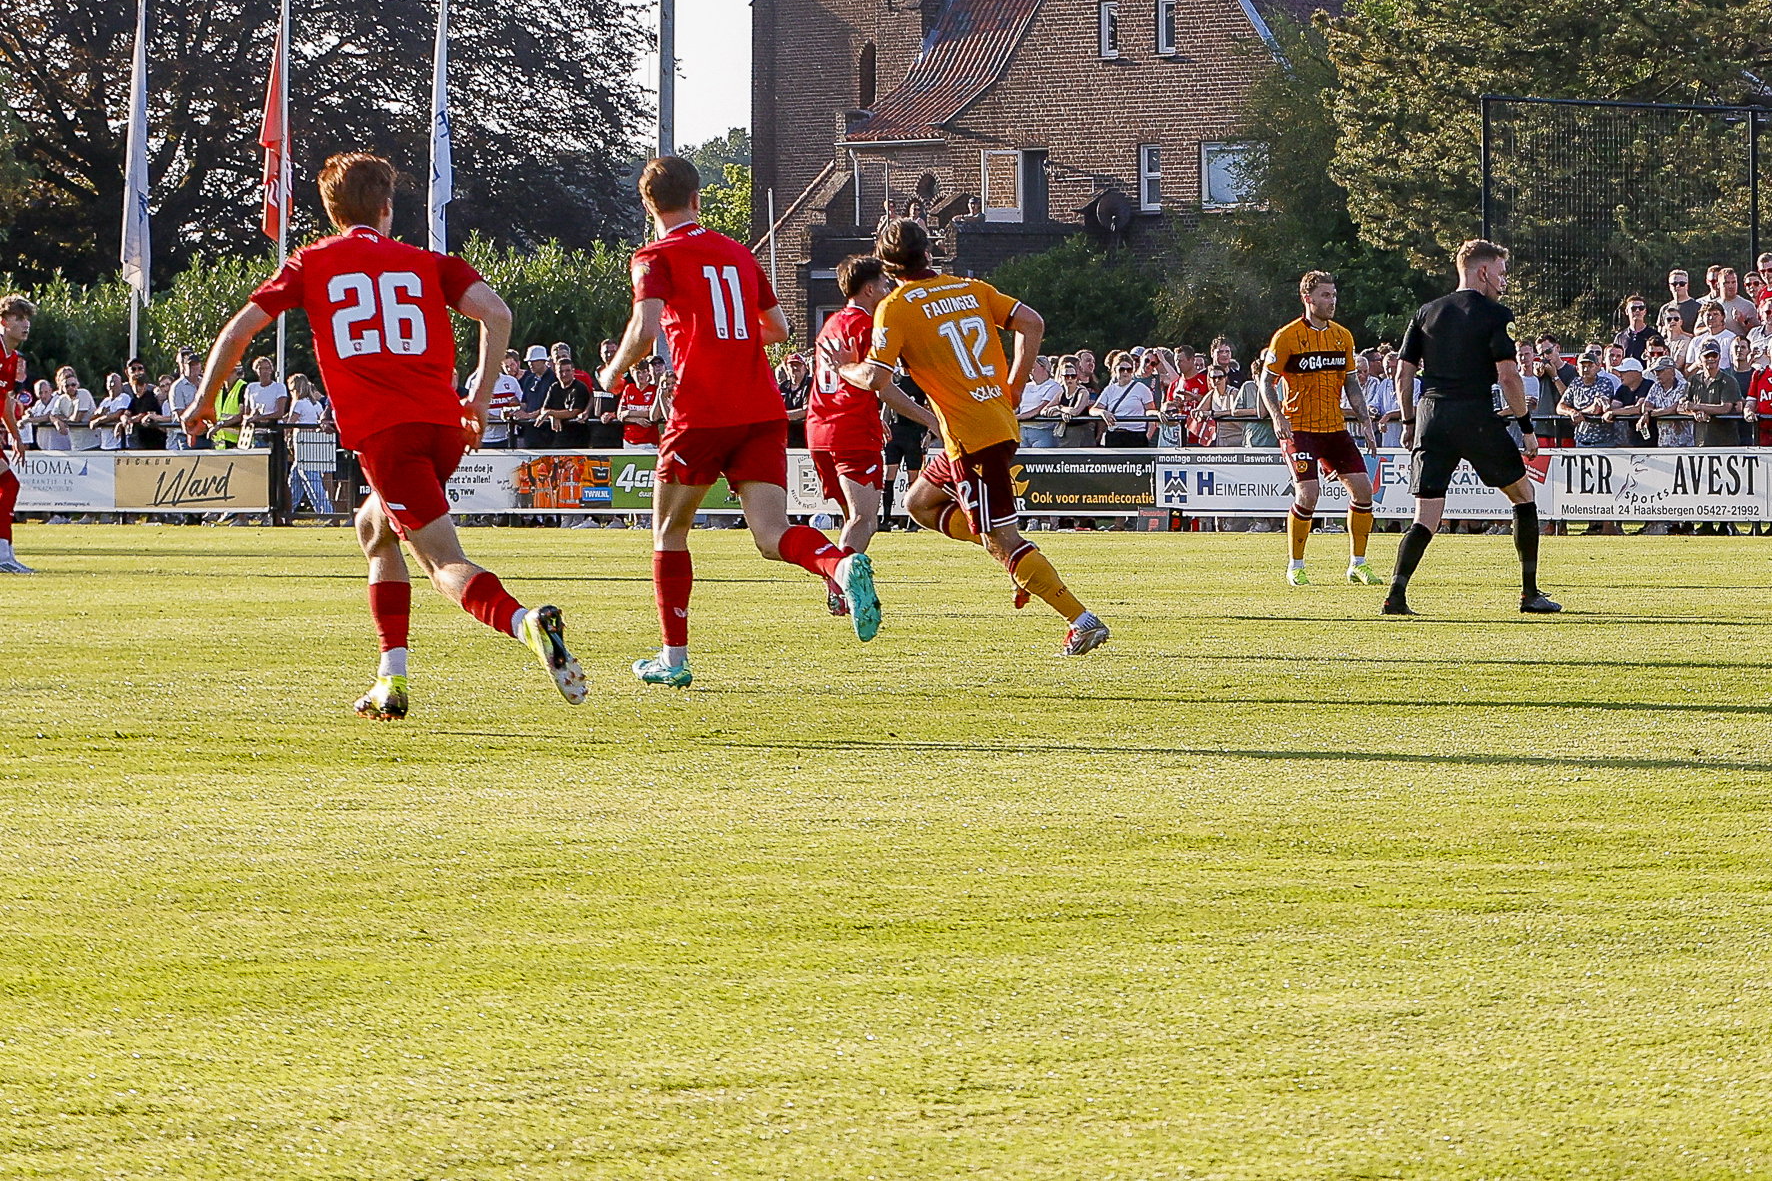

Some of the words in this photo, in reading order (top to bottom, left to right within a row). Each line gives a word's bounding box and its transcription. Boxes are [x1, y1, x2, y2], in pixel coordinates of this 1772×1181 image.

[702, 265, 750, 340] 11
[922, 294, 980, 320] FADINGER
[327, 271, 428, 359] 26
[938, 316, 995, 379] 12
[1309, 356, 1323, 370] G4
[1322, 357, 1346, 367] CLAIMS
[1159, 456, 1191, 464] montage
[1196, 454, 1238, 463] onderhoud
[1243, 454, 1273, 463] laswerk
[1291, 452, 1313, 460] TCL
[474, 464, 485, 473] doe
[487, 464, 493, 474] je
[1026, 460, 1154, 475] www.siemarzonwering.nl
[153, 456, 234, 505] Ward
[461, 476, 471, 484] z'n
[472, 475, 491, 484] allen!
[1561, 455, 1613, 495] TER
[1672, 455, 1760, 496] AVEST
[1197, 471, 1279, 497] HEIMERINK
[1448, 487, 1495, 495] BENTELO
[584, 490, 609, 498] TWW.NL
[1032, 492, 1053, 504] Ook
[1056, 495, 1079, 504] voor
[1082, 492, 1155, 505] raamdecoratie
[1624, 488, 1670, 505] sports
[1561, 504, 1614, 515] Molenstraat
[1618, 505, 1630, 515] 24
[1634, 504, 1695, 517] Haaksbergen
[1697, 505, 1760, 516] 05427-21992
